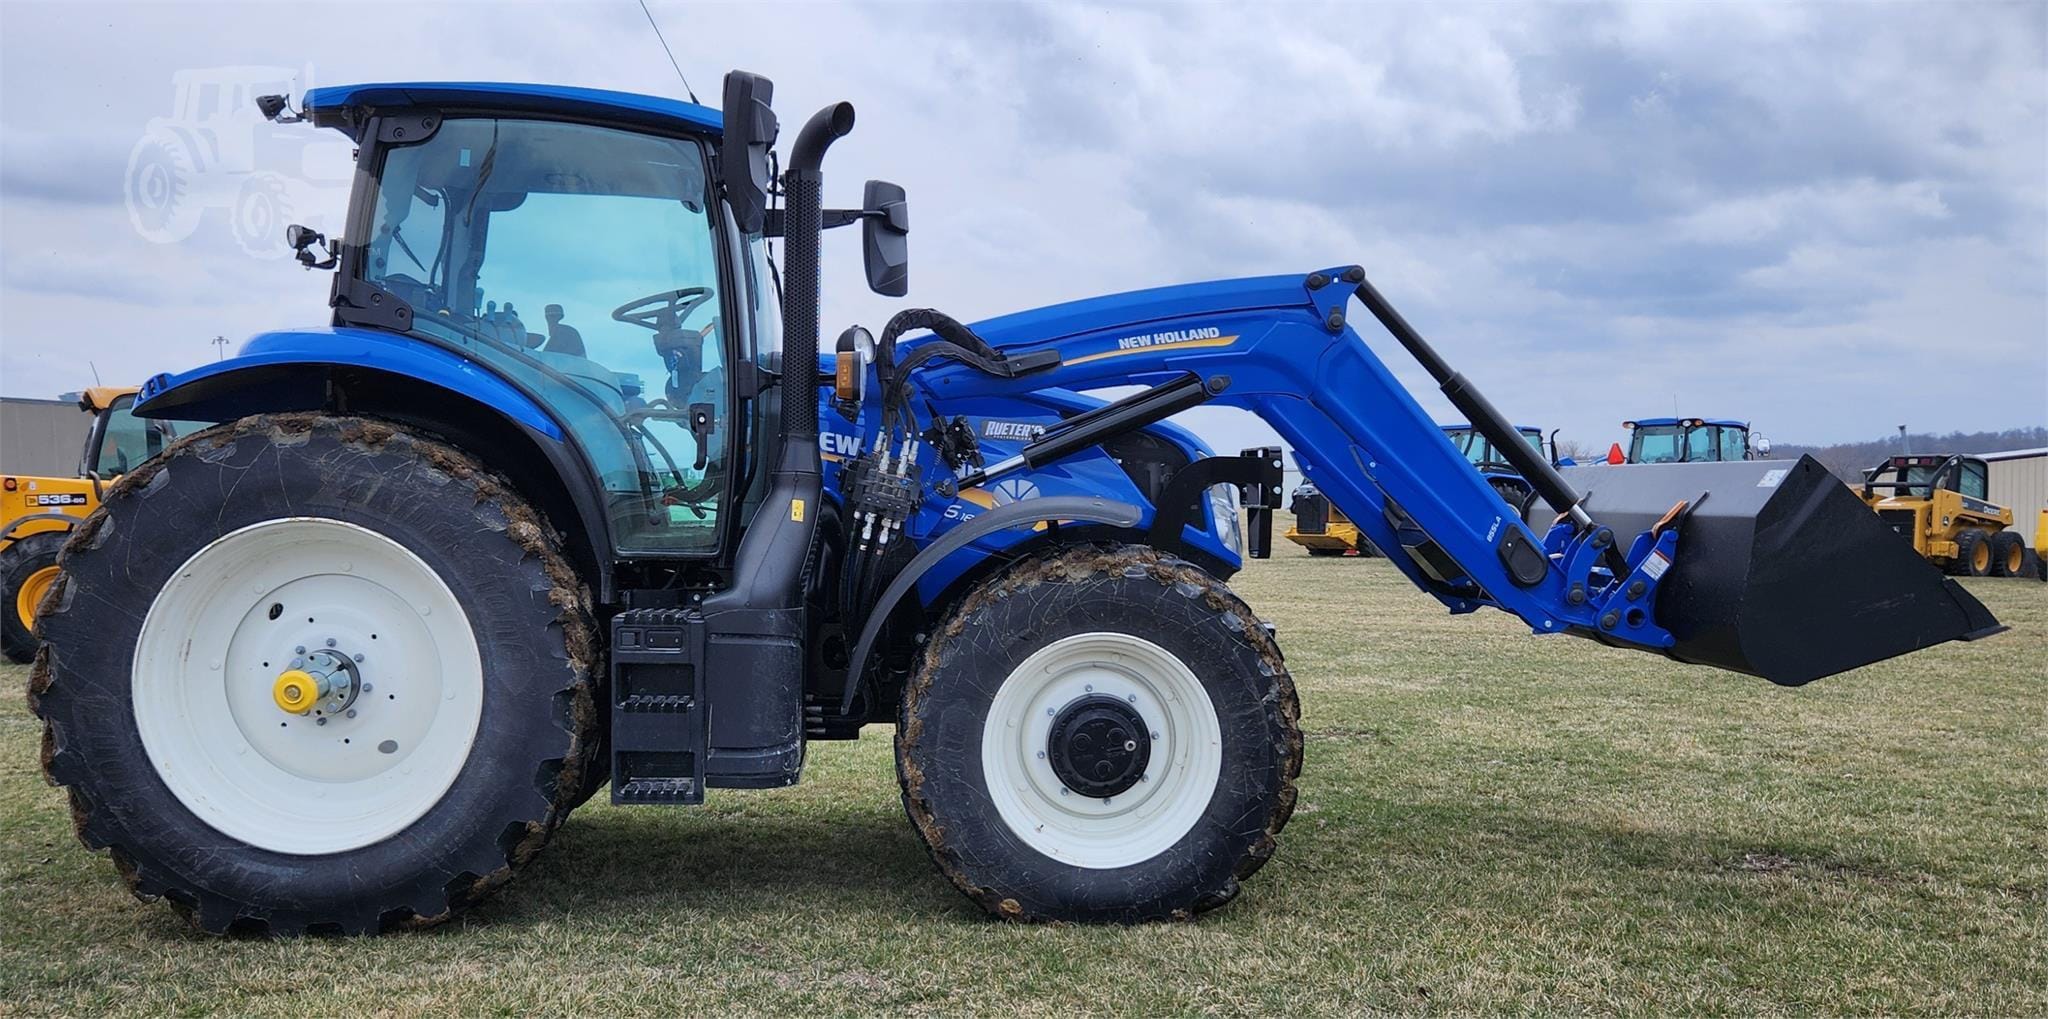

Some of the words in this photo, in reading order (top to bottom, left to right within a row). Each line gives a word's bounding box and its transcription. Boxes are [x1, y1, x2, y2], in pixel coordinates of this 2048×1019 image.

[1118, 335, 1152, 349] NEW
[1153, 327, 1220, 345] HOLLAND
[819, 432, 861, 456] EW
